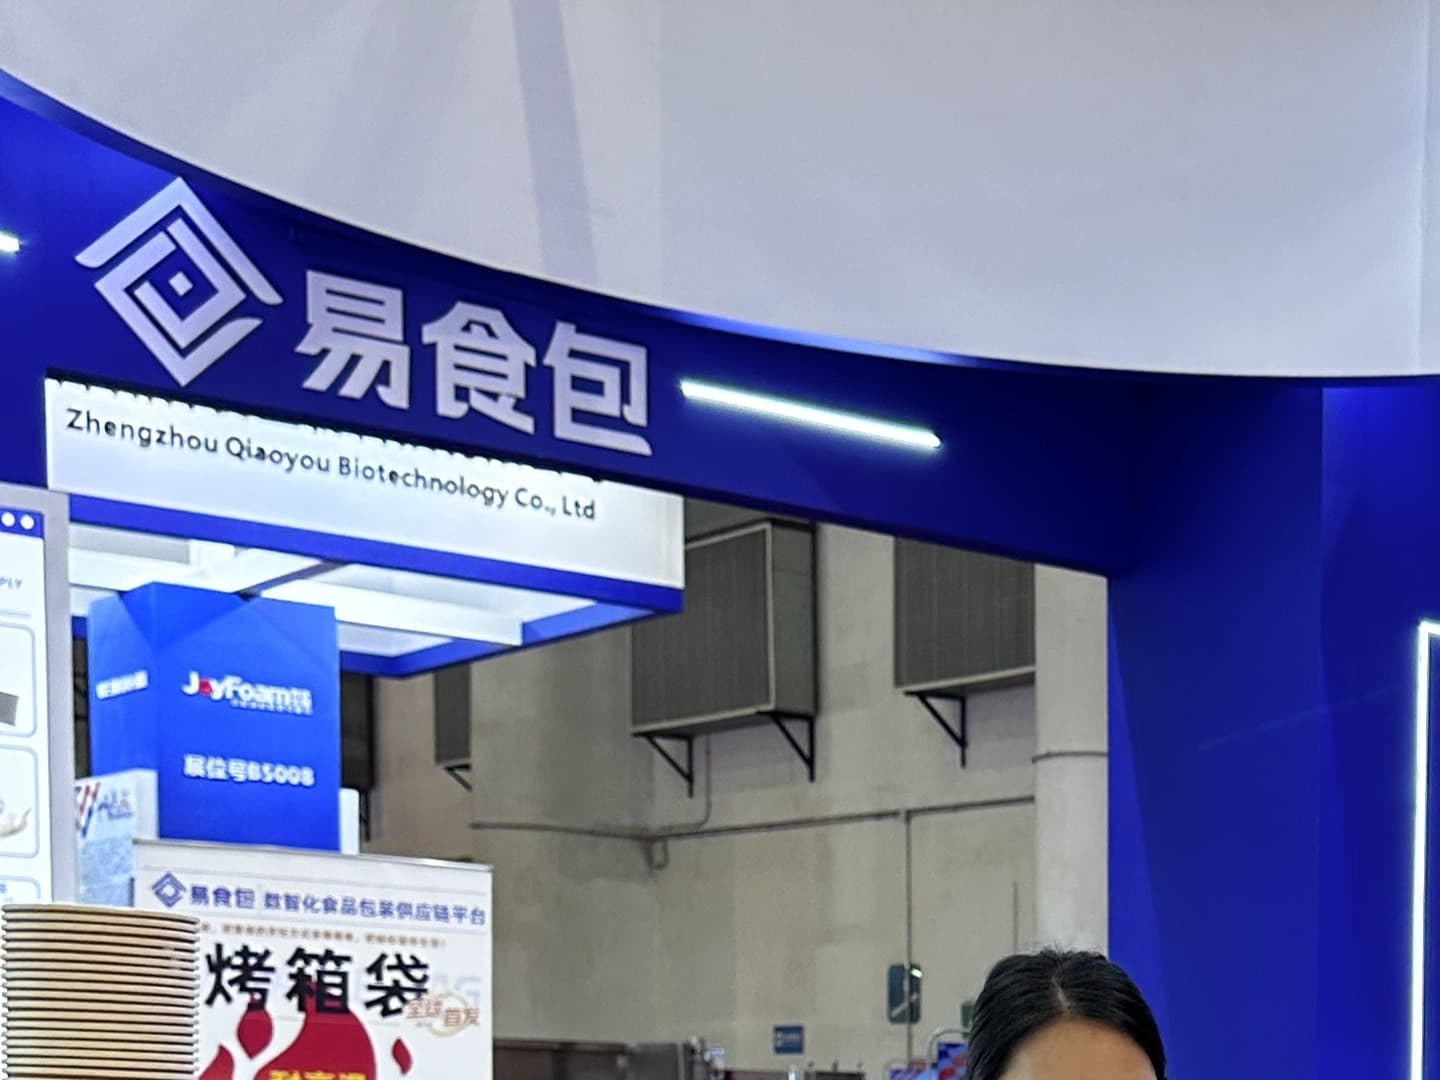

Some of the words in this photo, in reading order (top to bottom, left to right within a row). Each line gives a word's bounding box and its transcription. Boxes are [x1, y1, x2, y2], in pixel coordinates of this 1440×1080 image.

[294, 269, 652, 457] 易食包
[66, 408, 219, 453] Zhengzhou
[225, 435, 331, 473] Qiaoyou
[338, 457, 509, 508] Biotechnology
[562, 494, 596, 520] Ltd
[189, 883, 256, 910] 易食包
[204, 943, 429, 1018] 烤箱袋
